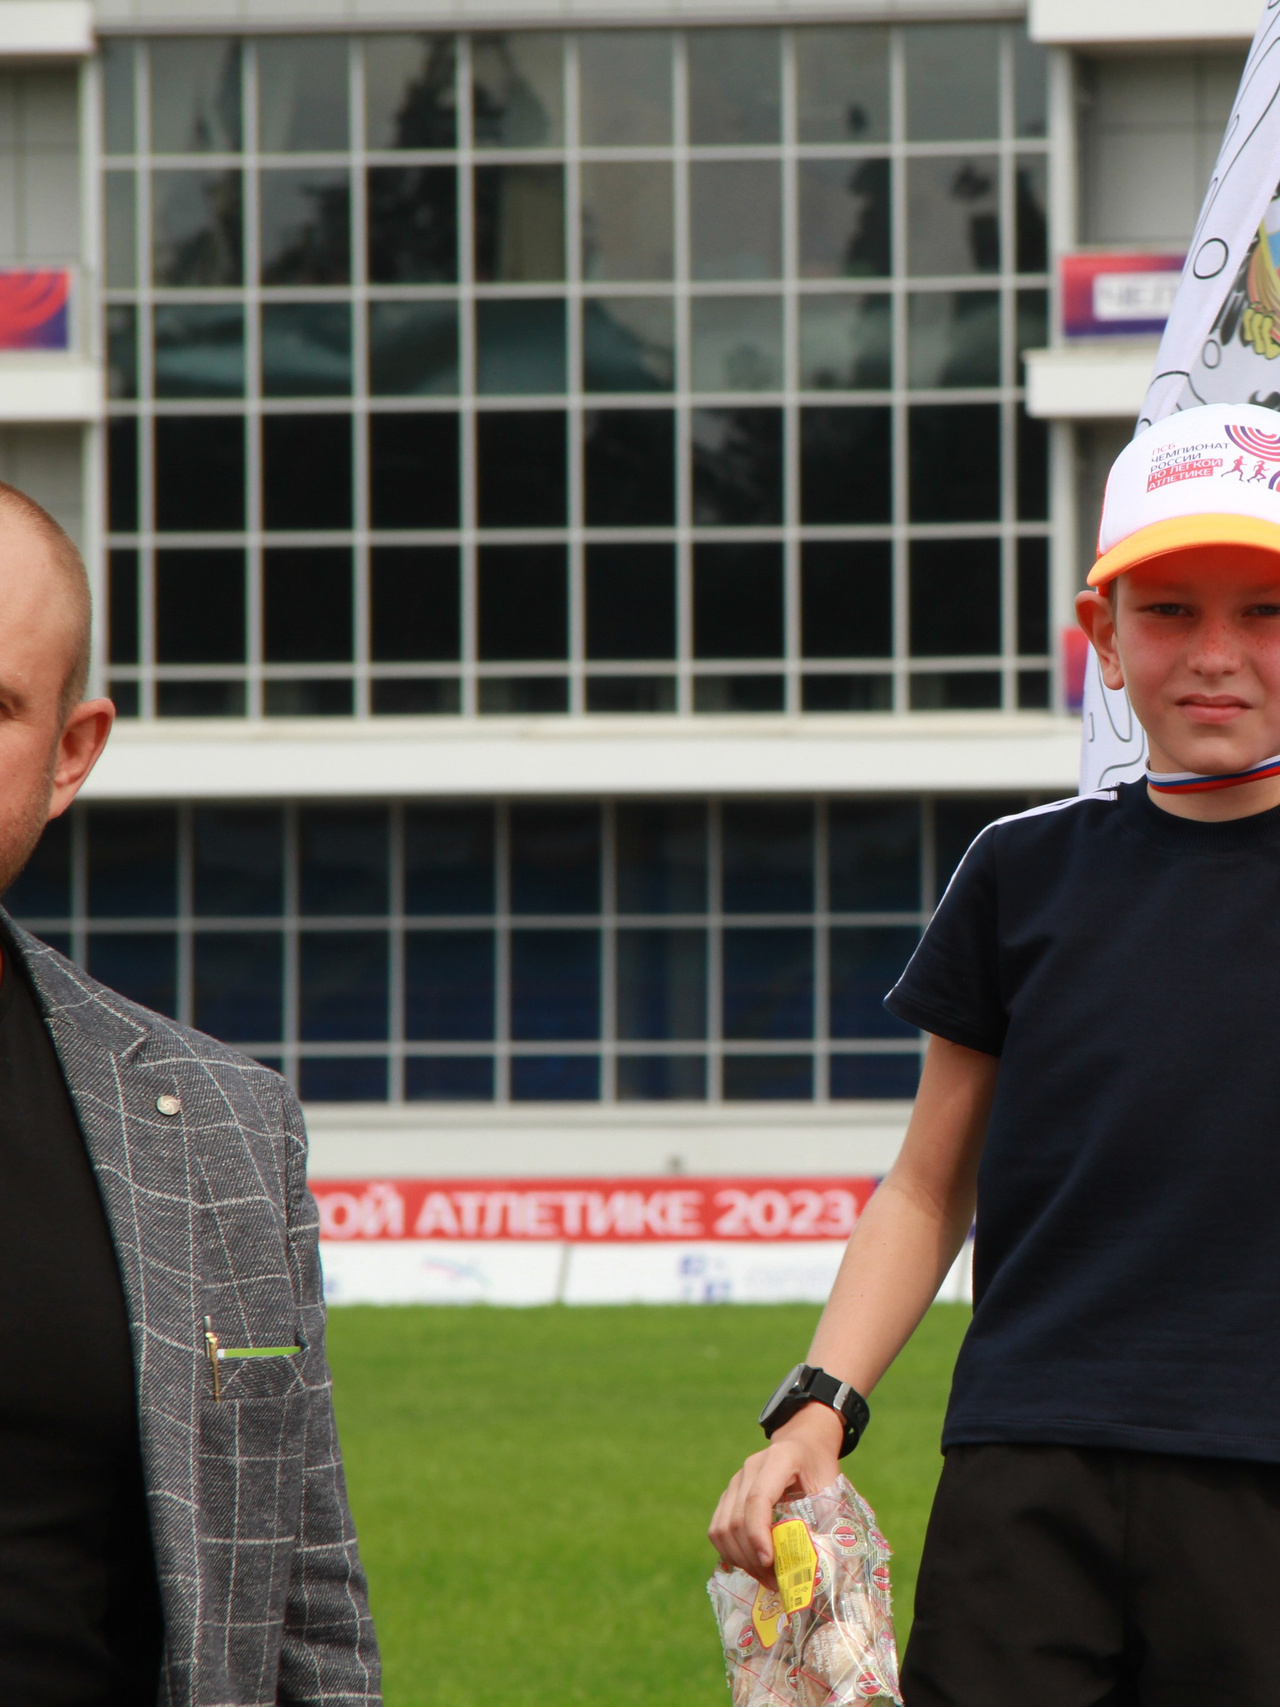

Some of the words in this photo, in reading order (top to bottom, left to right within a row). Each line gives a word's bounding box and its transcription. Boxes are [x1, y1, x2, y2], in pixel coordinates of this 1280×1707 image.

[1150, 452, 1202, 473] РОССИИ
[1151, 442, 1230, 463] ЧЕМПИОНАТ
[1148, 468, 1212, 491] АТЛЕТИКЕ
[1149, 470, 1167, 482] ПО
[316, 1182, 405, 1237] ОЙ
[414, 1190, 703, 1237] АТЛЕТИКЕ
[712, 1189, 857, 1237] 2023
